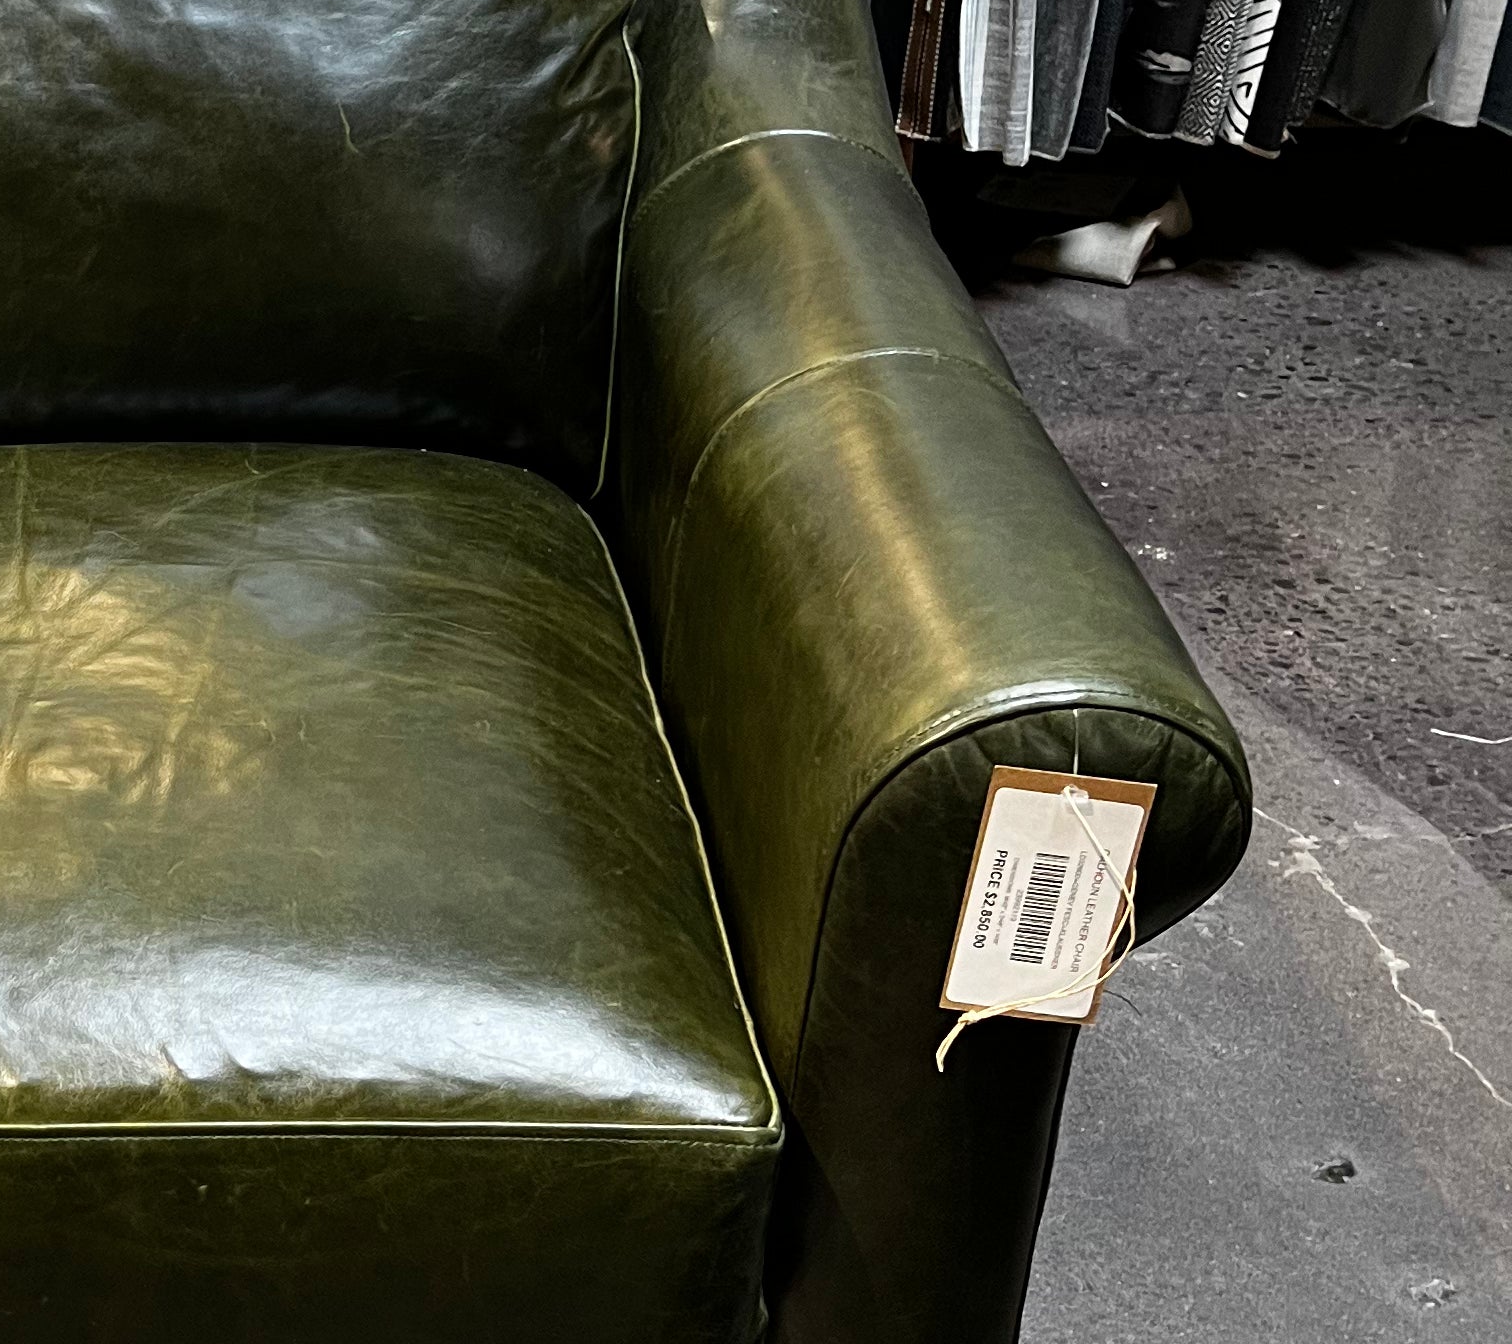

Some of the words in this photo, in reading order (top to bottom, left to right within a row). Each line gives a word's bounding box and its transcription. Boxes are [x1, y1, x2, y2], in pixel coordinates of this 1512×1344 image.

[987, 849, 1009, 888] PRICE
[972, 891, 998, 949] $2,850.00
[1077, 898, 1097, 941] LEATHER
[1069, 943, 1085, 973] CHAIR
